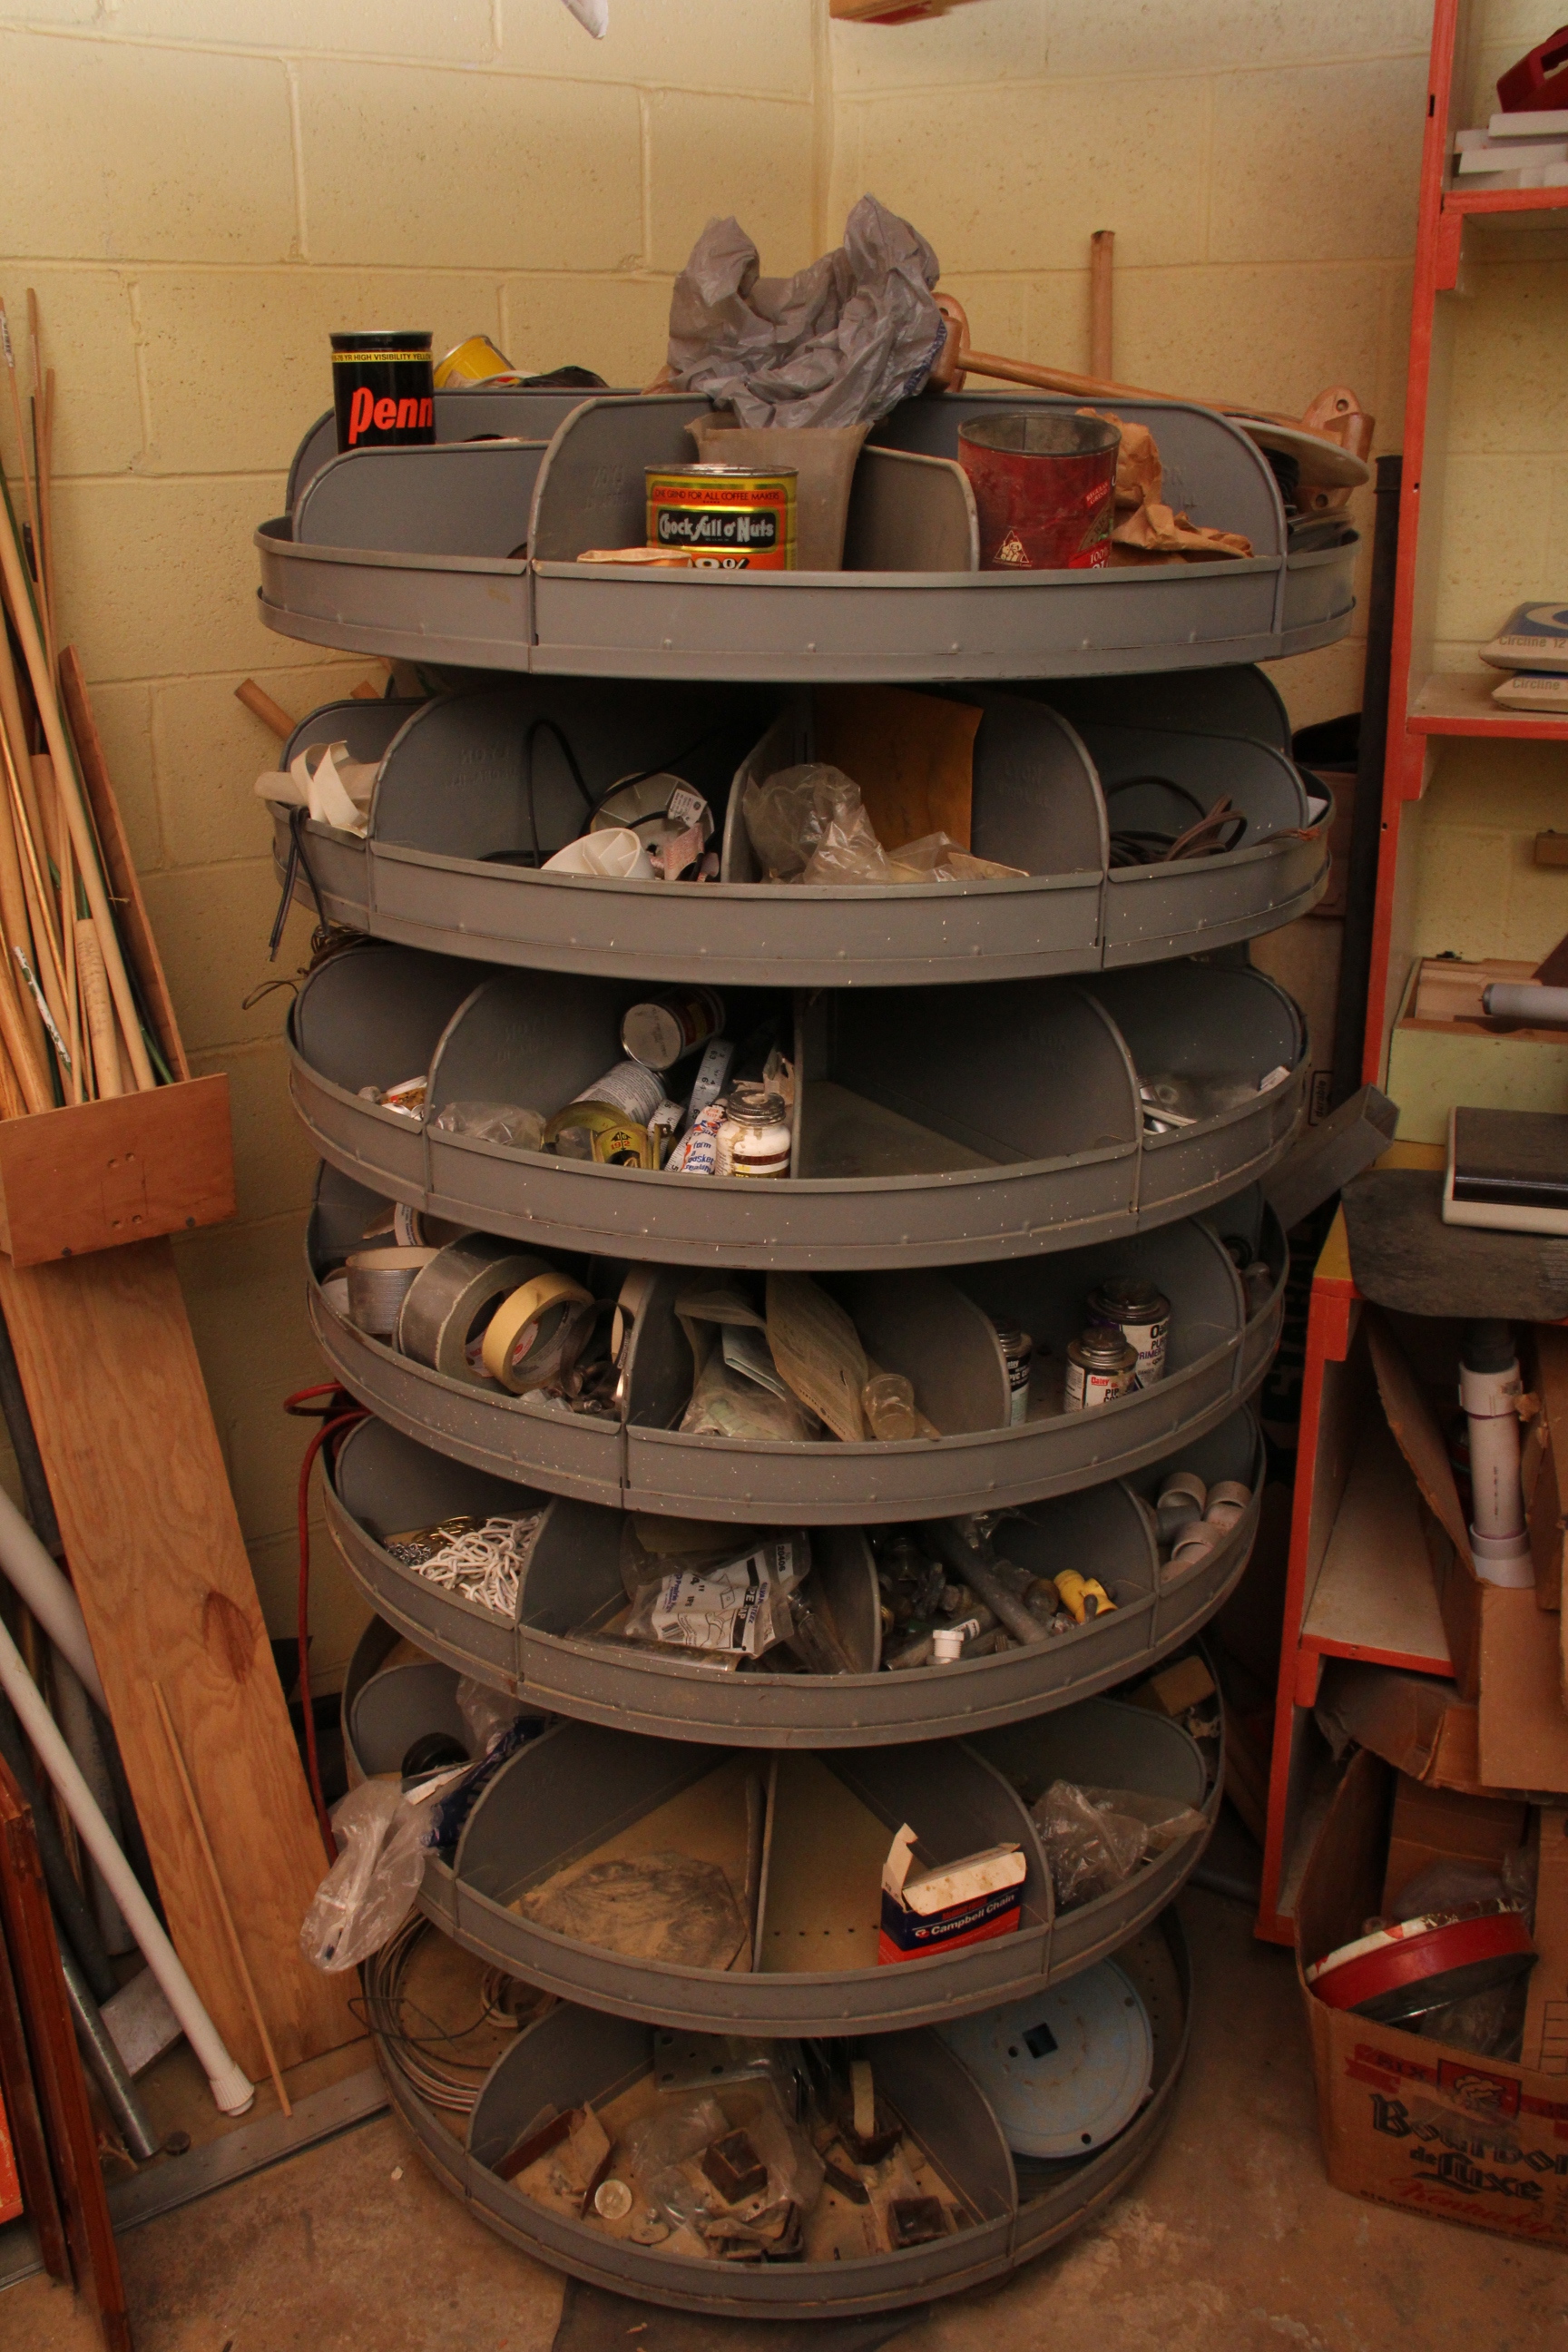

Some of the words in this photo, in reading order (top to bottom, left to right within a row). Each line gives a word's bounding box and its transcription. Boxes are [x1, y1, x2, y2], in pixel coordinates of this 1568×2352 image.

[655, 490, 666, 498] ONE
[667, 490, 685, 498] GRIND
[688, 491, 701, 499] FOR
[704, 492, 719, 500] ALL
[721, 493, 749, 501] COFFEE
[751, 492, 780, 501] MAKERS
[659, 513, 694, 540] Chock
[691, 514, 722, 542] full
[737, 515, 774, 543] Nuts
[1499, 635, 1547, 648] Circline
[1553, 637, 1566, 649] 12
[1512, 678, 1561, 691] Circline
[1315, 1080, 1326, 1118] durable
[693, 1141, 711, 1149] form
[931, 1908, 985, 1936] Campbell
[985, 1894, 1015, 1915] Chain
[1409, 2145, 1437, 2165] de
[1426, 2151, 1544, 2200] Luxe
[1388, 2176, 1553, 2234] Kentucky
